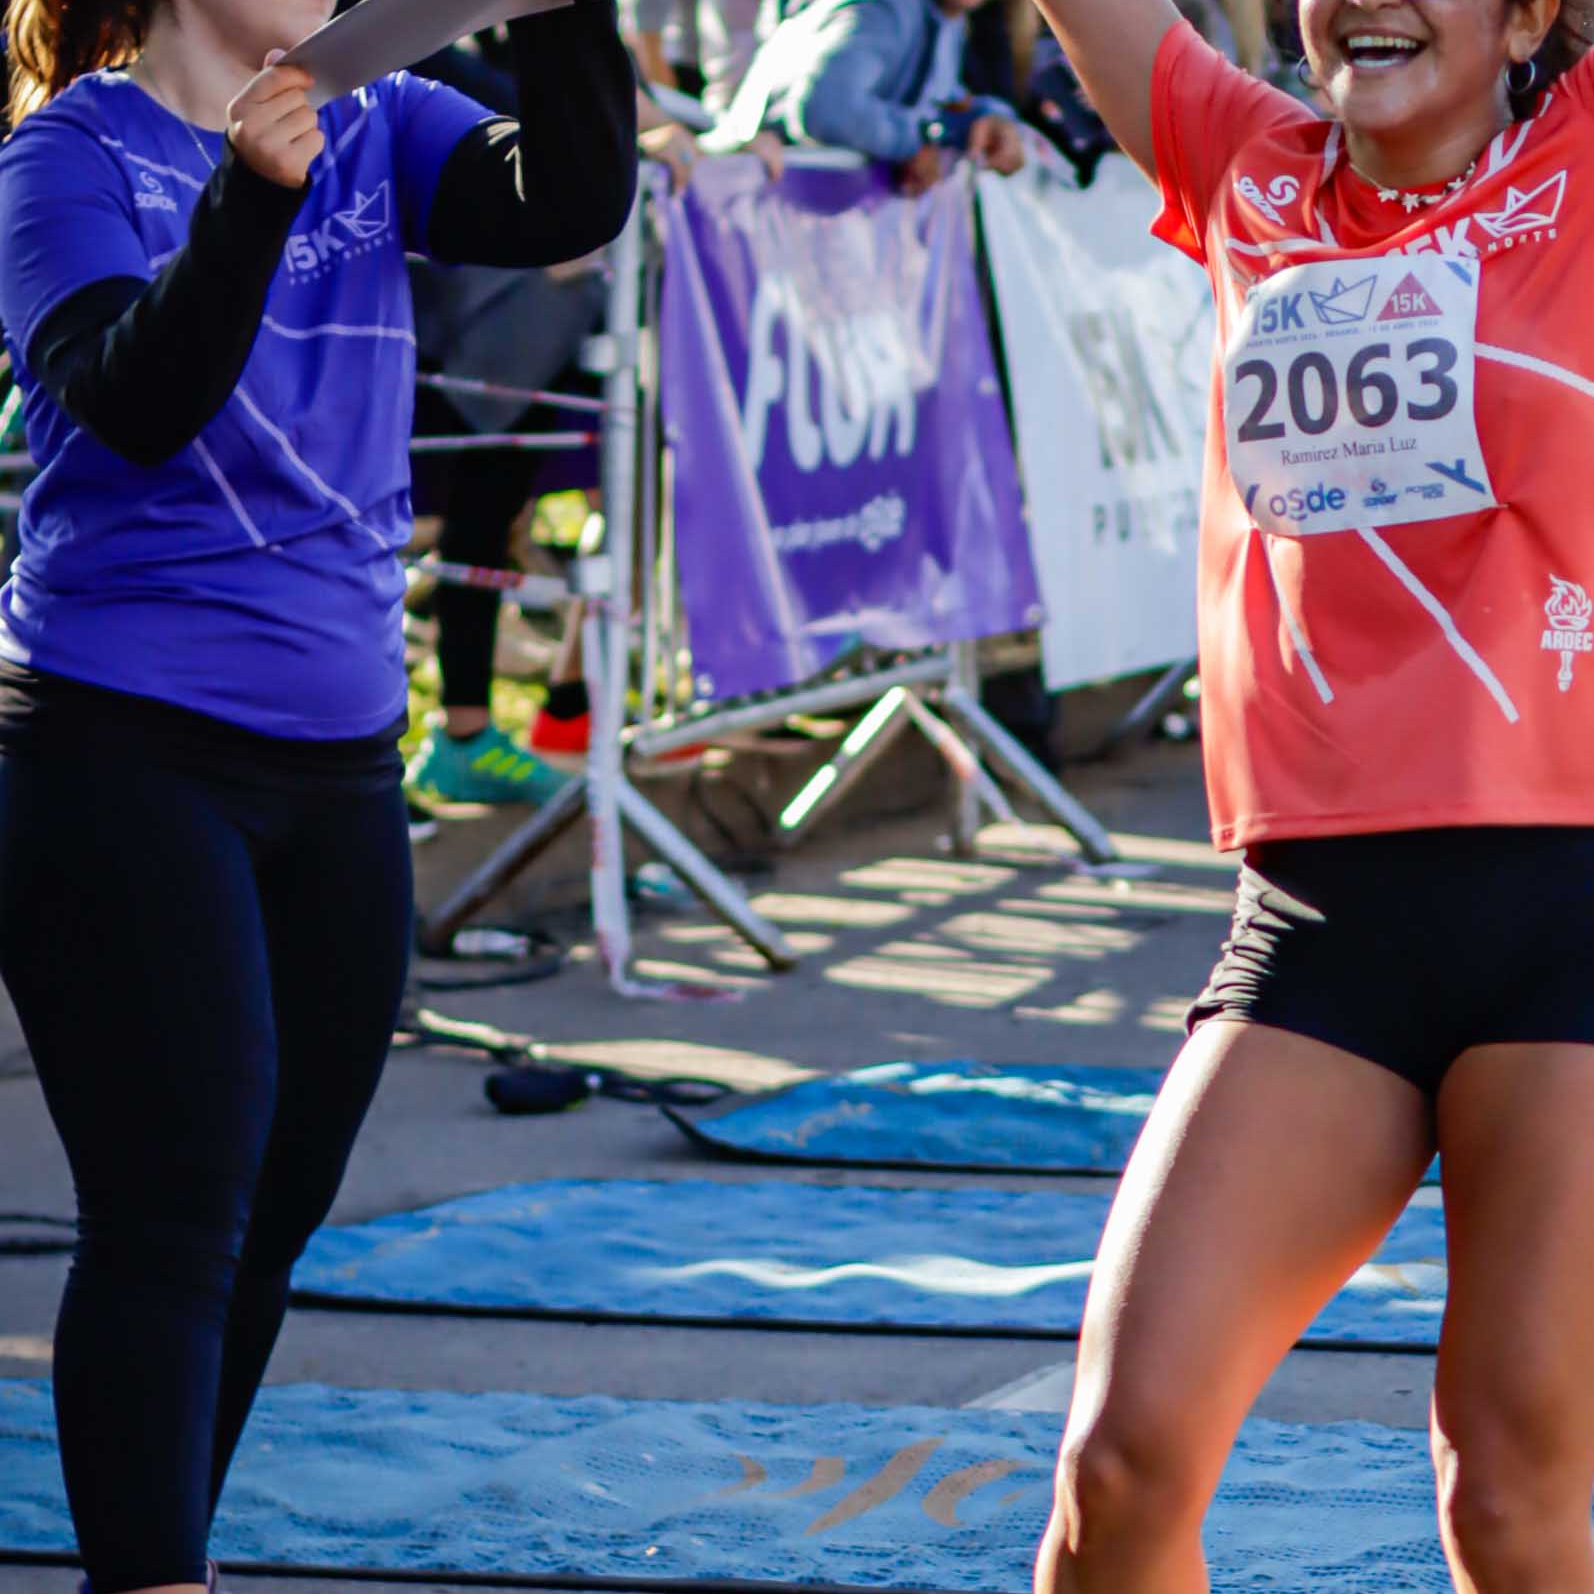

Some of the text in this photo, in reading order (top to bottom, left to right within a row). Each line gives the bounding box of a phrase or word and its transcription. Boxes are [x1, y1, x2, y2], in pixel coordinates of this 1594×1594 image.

[1390, 292, 1427, 314] 15K
[1234, 336, 1459, 443] 2063
[1389, 435, 1418, 452] Luz
[1269, 481, 1346, 521] osde
[1540, 628, 1594, 652] ARDEC
